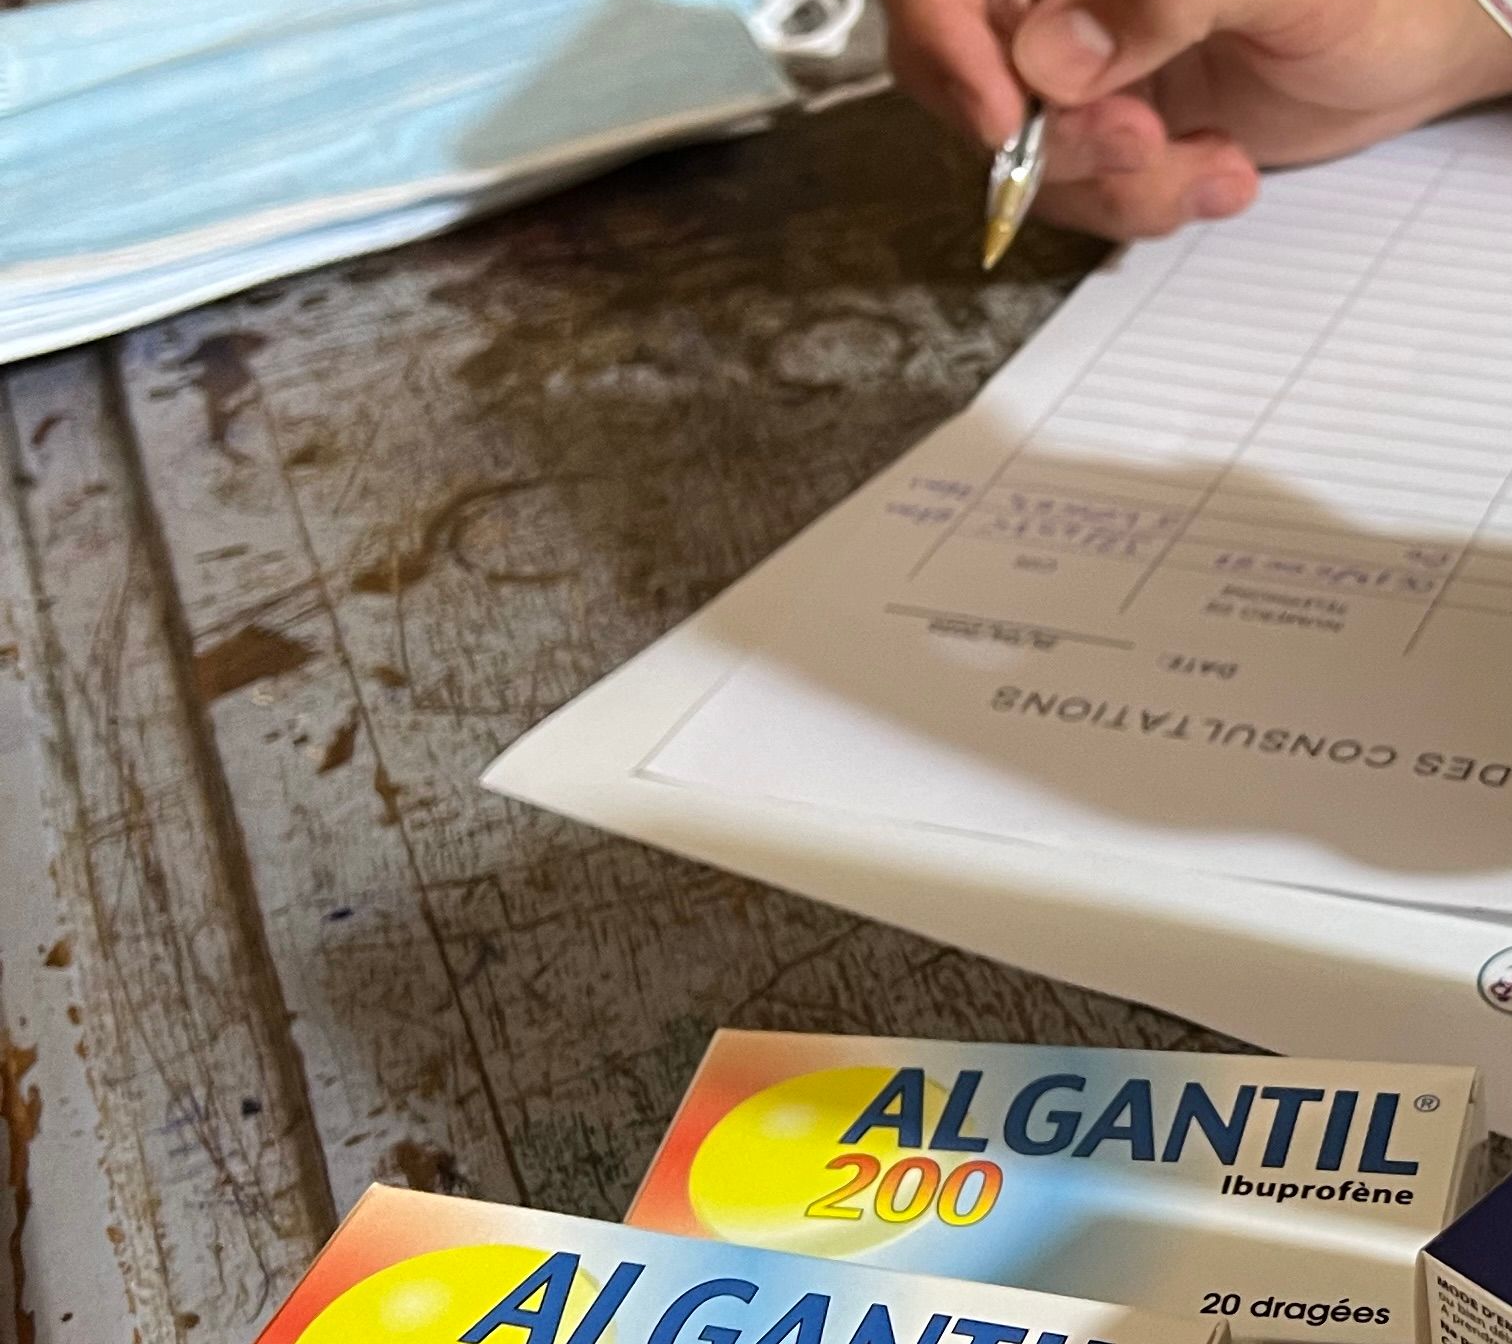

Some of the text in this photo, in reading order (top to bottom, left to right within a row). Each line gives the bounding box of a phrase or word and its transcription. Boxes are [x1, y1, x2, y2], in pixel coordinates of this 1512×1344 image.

[993, 687, 1396, 768] CONSULTATIONS
[1414, 753, 1512, 788] DES
[840, 1067, 1420, 1175] ALGANTIL
[805, 1153, 1003, 1227] 200
[1222, 1174, 1415, 1206] Ibuprofène
[1200, 1292, 1391, 1326] 20 dragées
